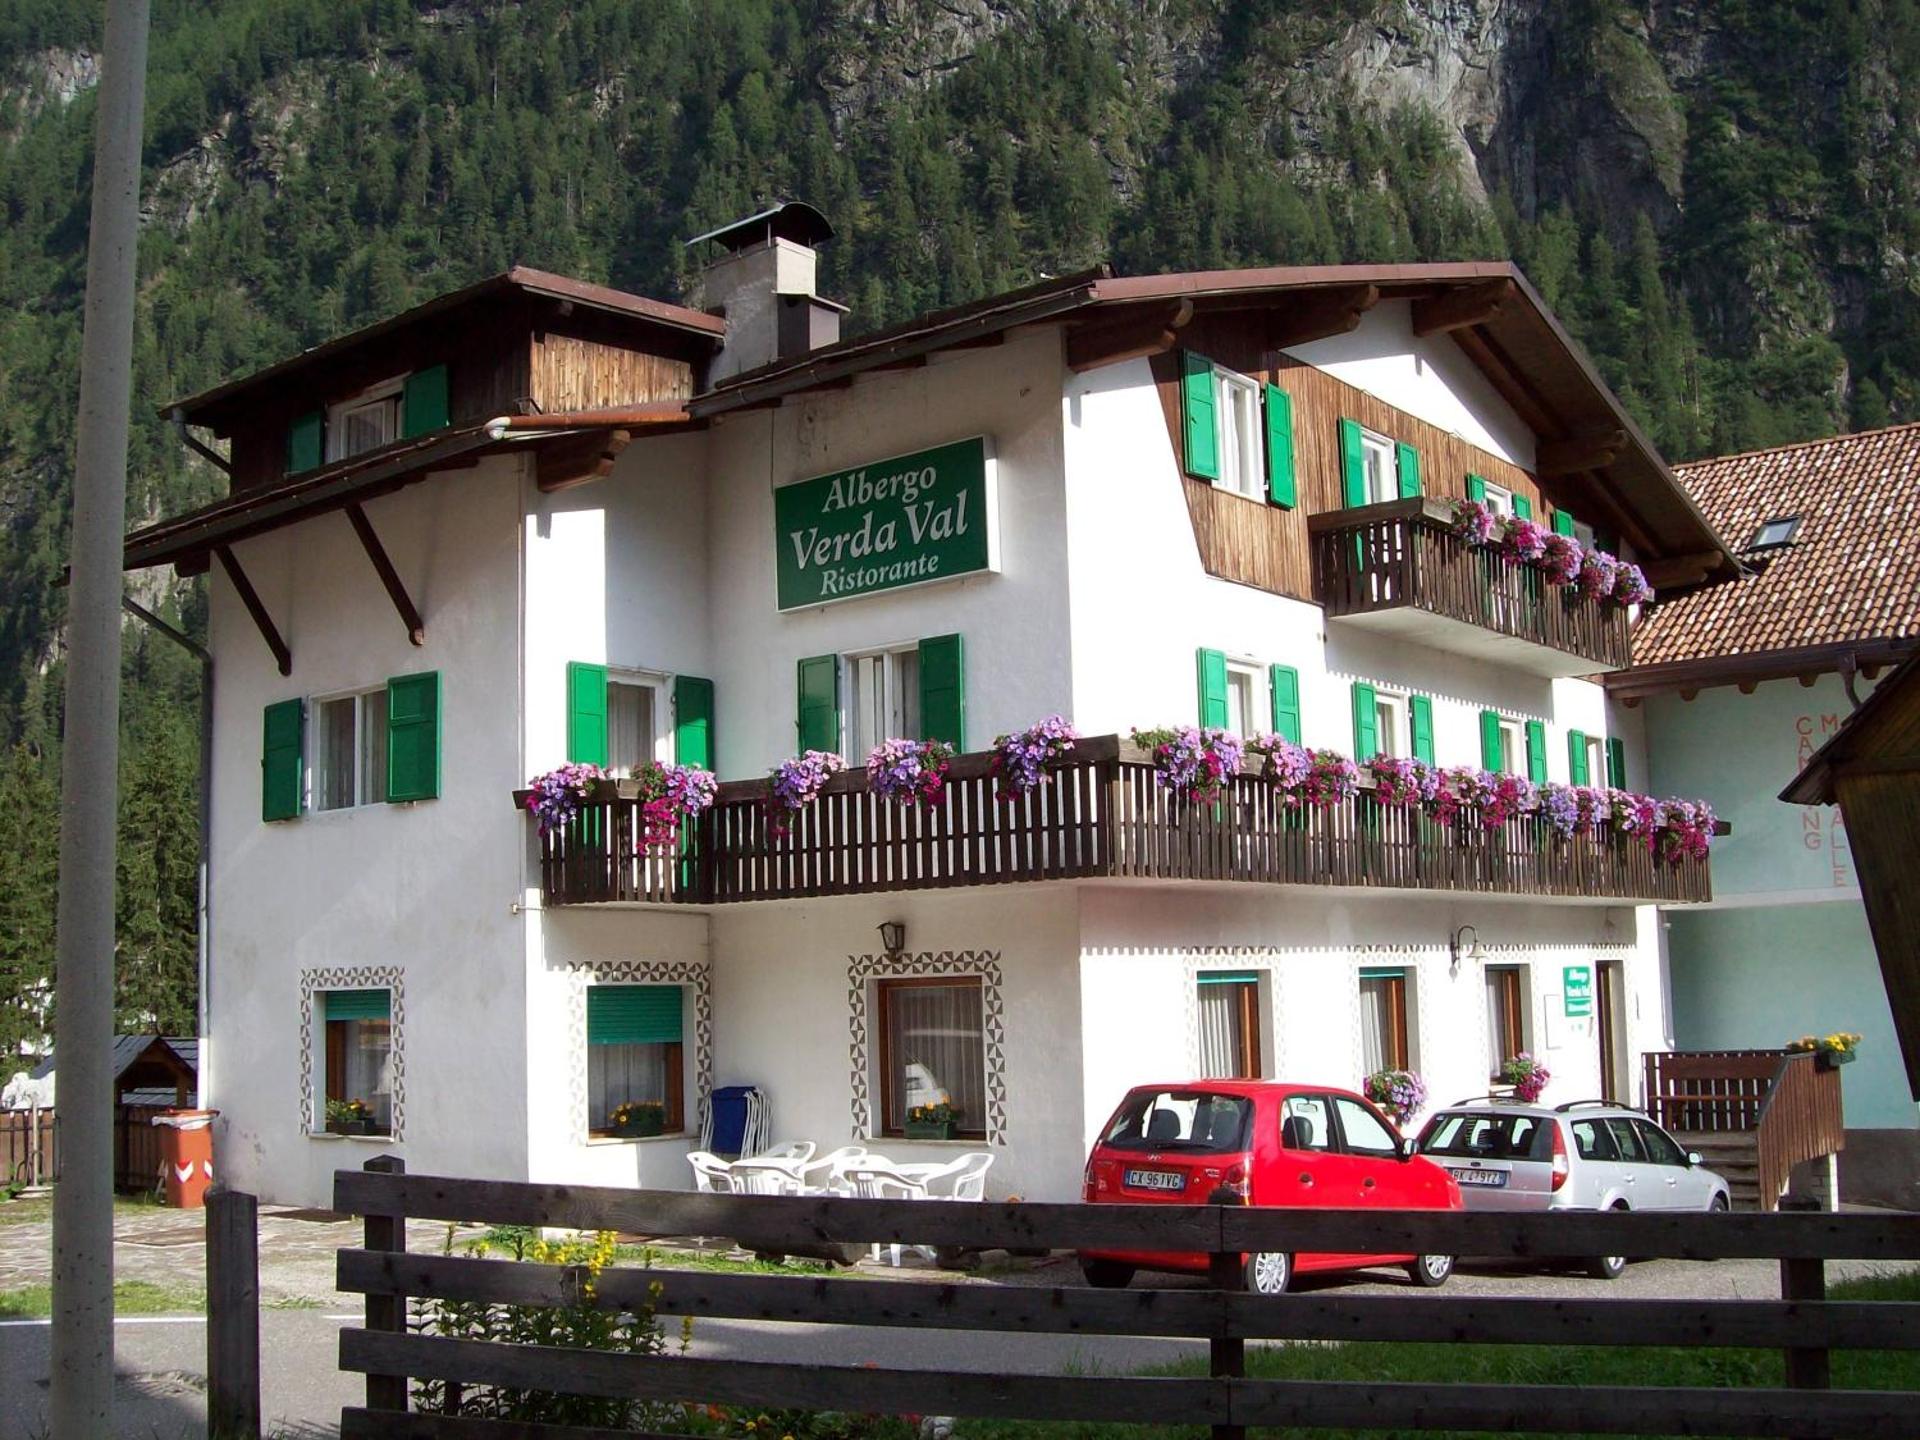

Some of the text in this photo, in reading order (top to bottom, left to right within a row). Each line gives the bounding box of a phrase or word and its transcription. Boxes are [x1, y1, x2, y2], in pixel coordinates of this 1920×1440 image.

[821, 466, 937, 513] Albergo
[790, 488, 969, 570] Verda Val
[820, 553, 939, 596] Ristorante
[1130, 1171, 1145, 1185] CX
